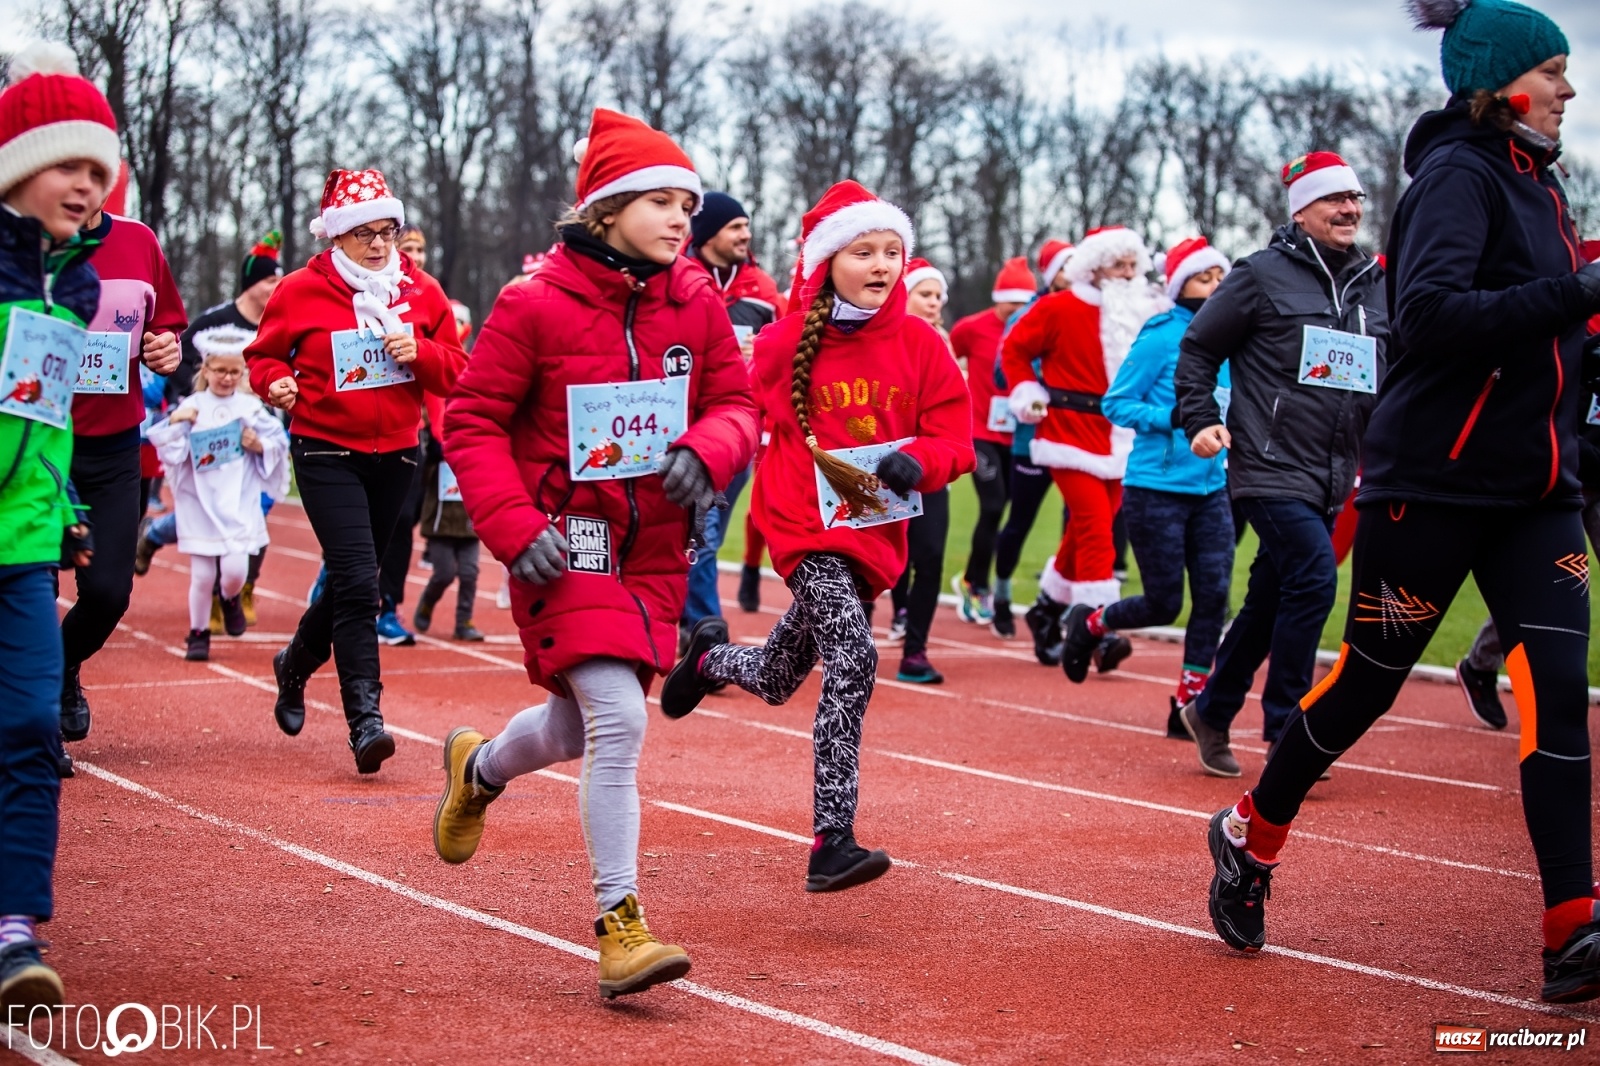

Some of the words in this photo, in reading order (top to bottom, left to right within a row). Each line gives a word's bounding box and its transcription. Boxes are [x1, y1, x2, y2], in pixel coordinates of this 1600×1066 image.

[363, 347, 387, 364] 011
[1328, 349, 1354, 366] 079
[611, 412, 658, 438] 044
[570, 519, 606, 537] APPLY
[570, 534, 607, 552] SOME
[573, 553, 606, 570] JUST
